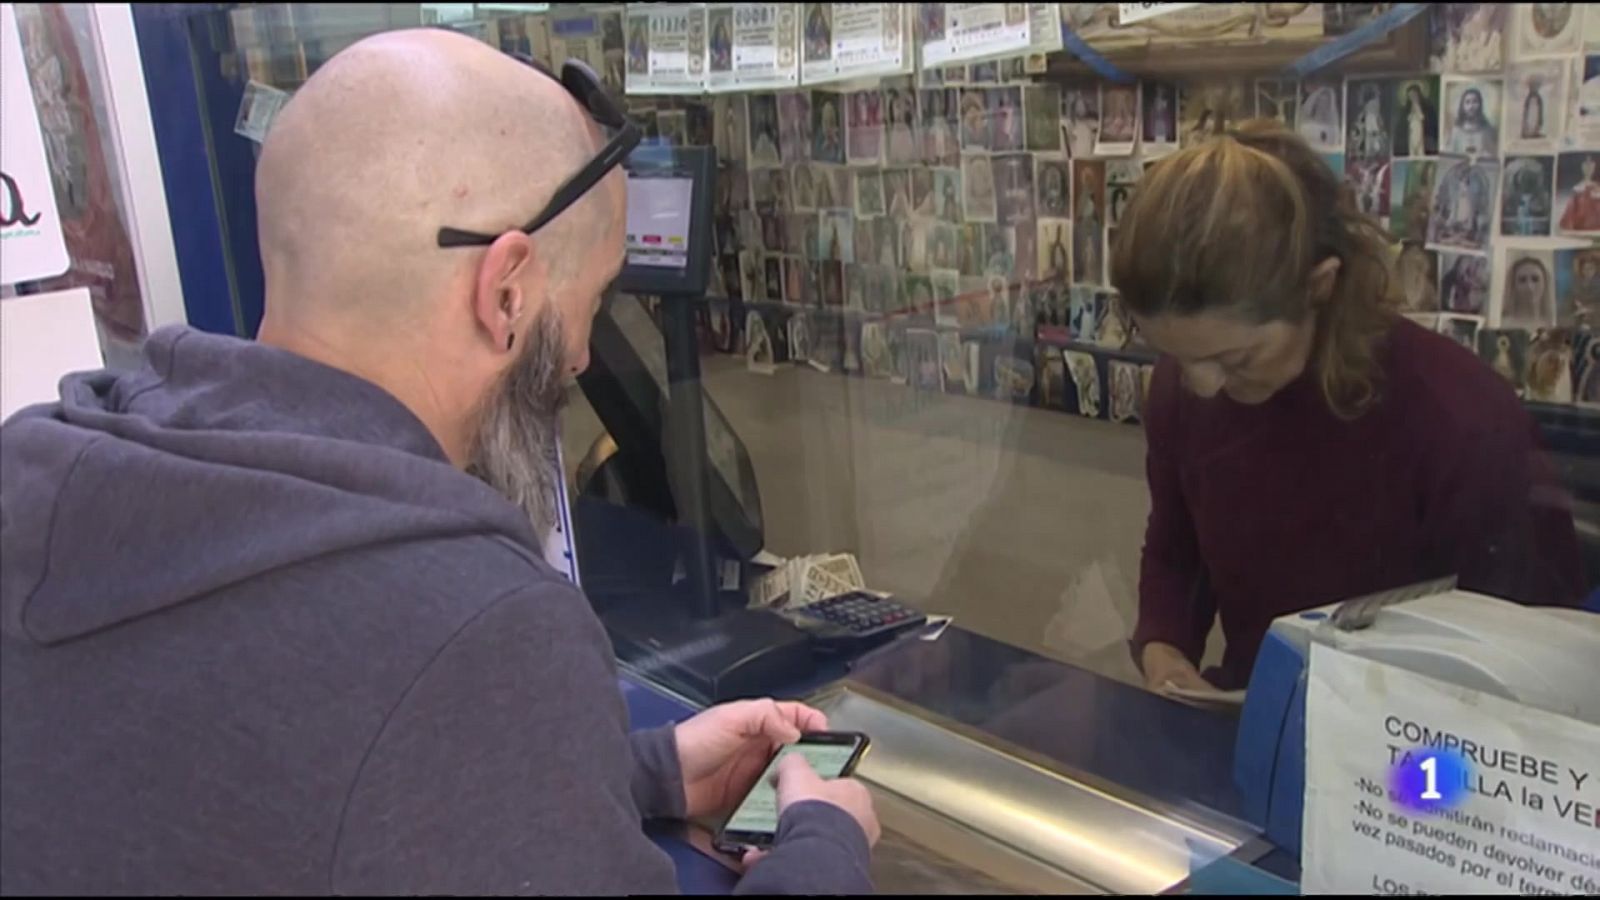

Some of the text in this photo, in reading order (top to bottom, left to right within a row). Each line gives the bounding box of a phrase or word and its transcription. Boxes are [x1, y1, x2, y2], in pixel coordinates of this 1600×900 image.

[1385, 716, 1588, 791] COMPRUEBE Y
[1354, 777, 1383, 797] -No
[1412, 798, 1495, 834] dmitirán
[1522, 786, 1543, 811] la
[1553, 796, 1600, 829] VE
[1352, 820, 1381, 840] vez
[1385, 830, 1456, 868] pasados
[1461, 859, 1491, 880] por
[1497, 872, 1513, 888] el
[1353, 801, 1383, 820] -No
[1387, 812, 1408, 828] se
[1412, 819, 1478, 853] pueden
[1484, 843, 1565, 883] devolver
